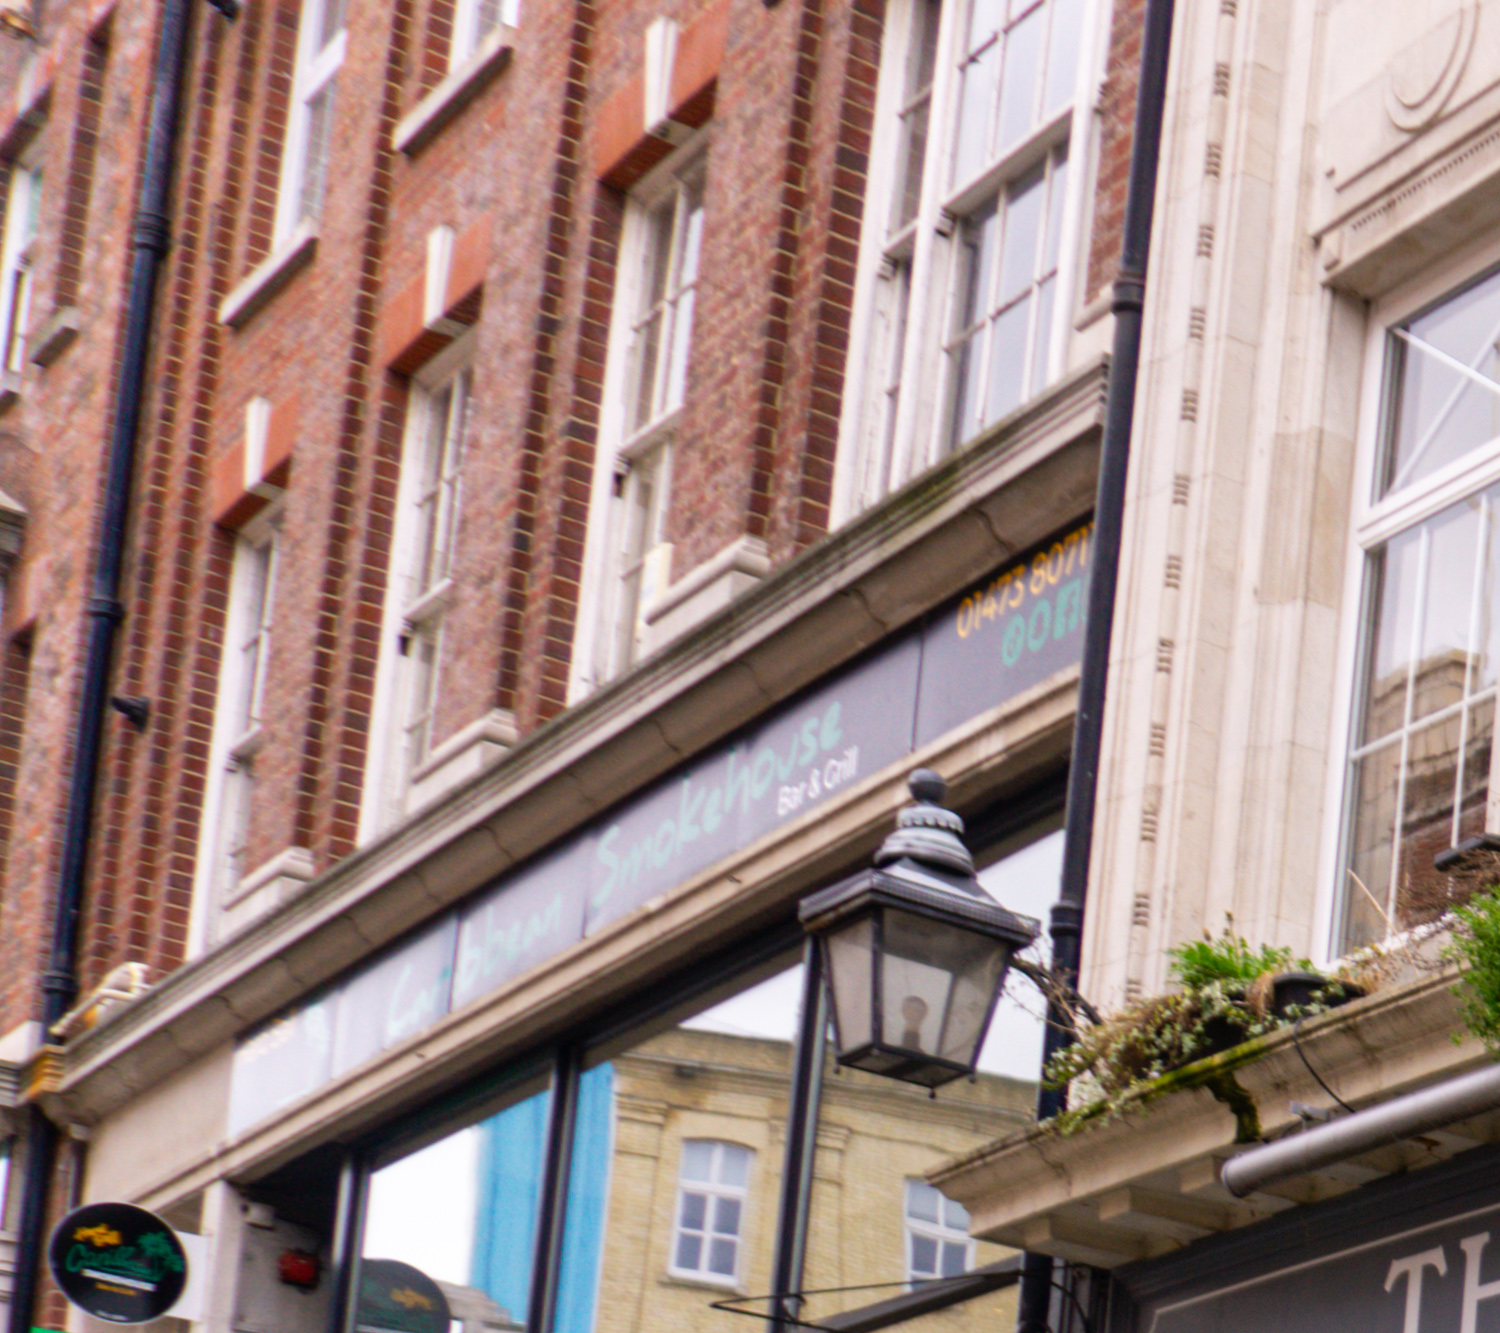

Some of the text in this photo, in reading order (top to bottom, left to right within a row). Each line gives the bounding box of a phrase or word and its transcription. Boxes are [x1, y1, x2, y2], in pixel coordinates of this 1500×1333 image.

[1029, 521, 1094, 596] 8071
[592, 700, 843, 908] Smokehouse
[777, 743, 859, 817] Bar & Grill
